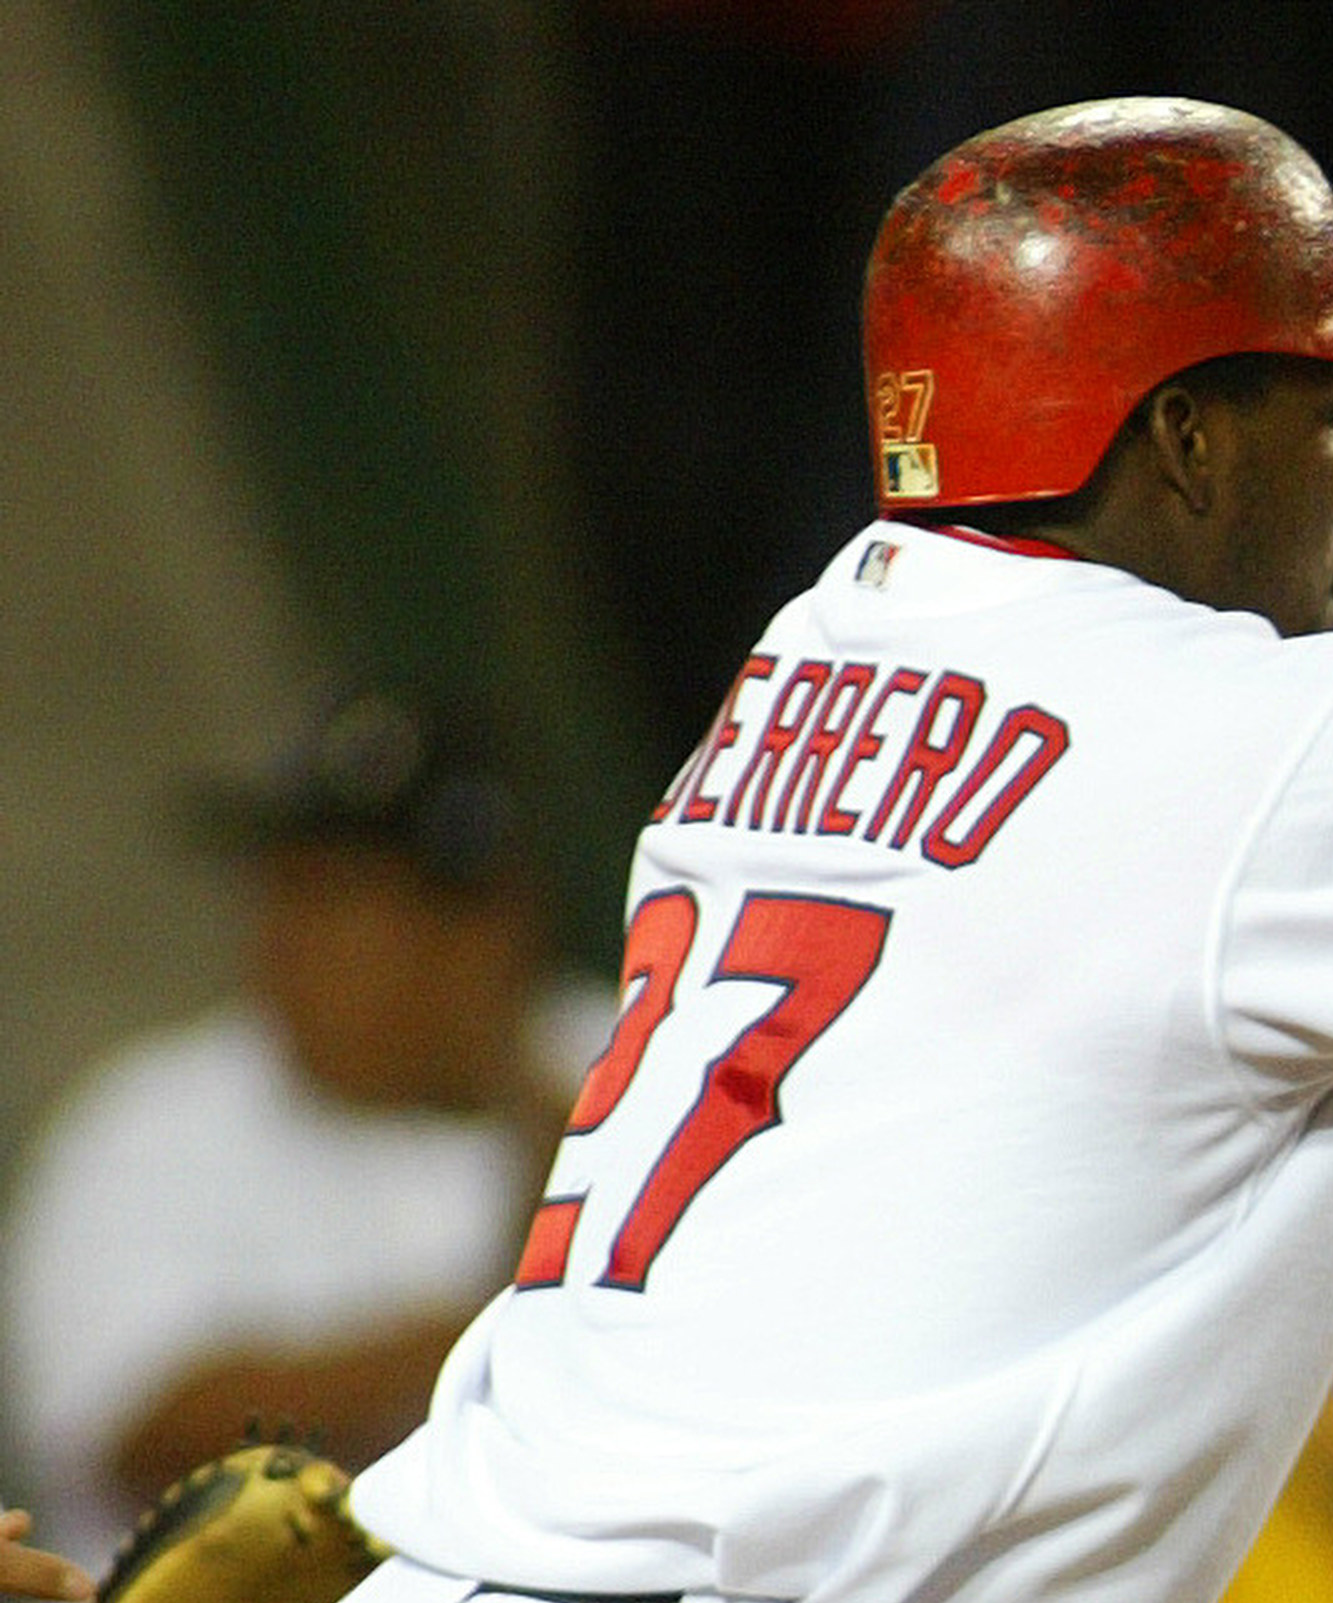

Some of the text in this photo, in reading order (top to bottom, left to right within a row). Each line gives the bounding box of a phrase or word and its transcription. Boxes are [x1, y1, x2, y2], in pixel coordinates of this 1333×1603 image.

[877, 368, 934, 443] 27
[652, 652, 1071, 870] ERRERO
[515, 885, 895, 1295] 27
